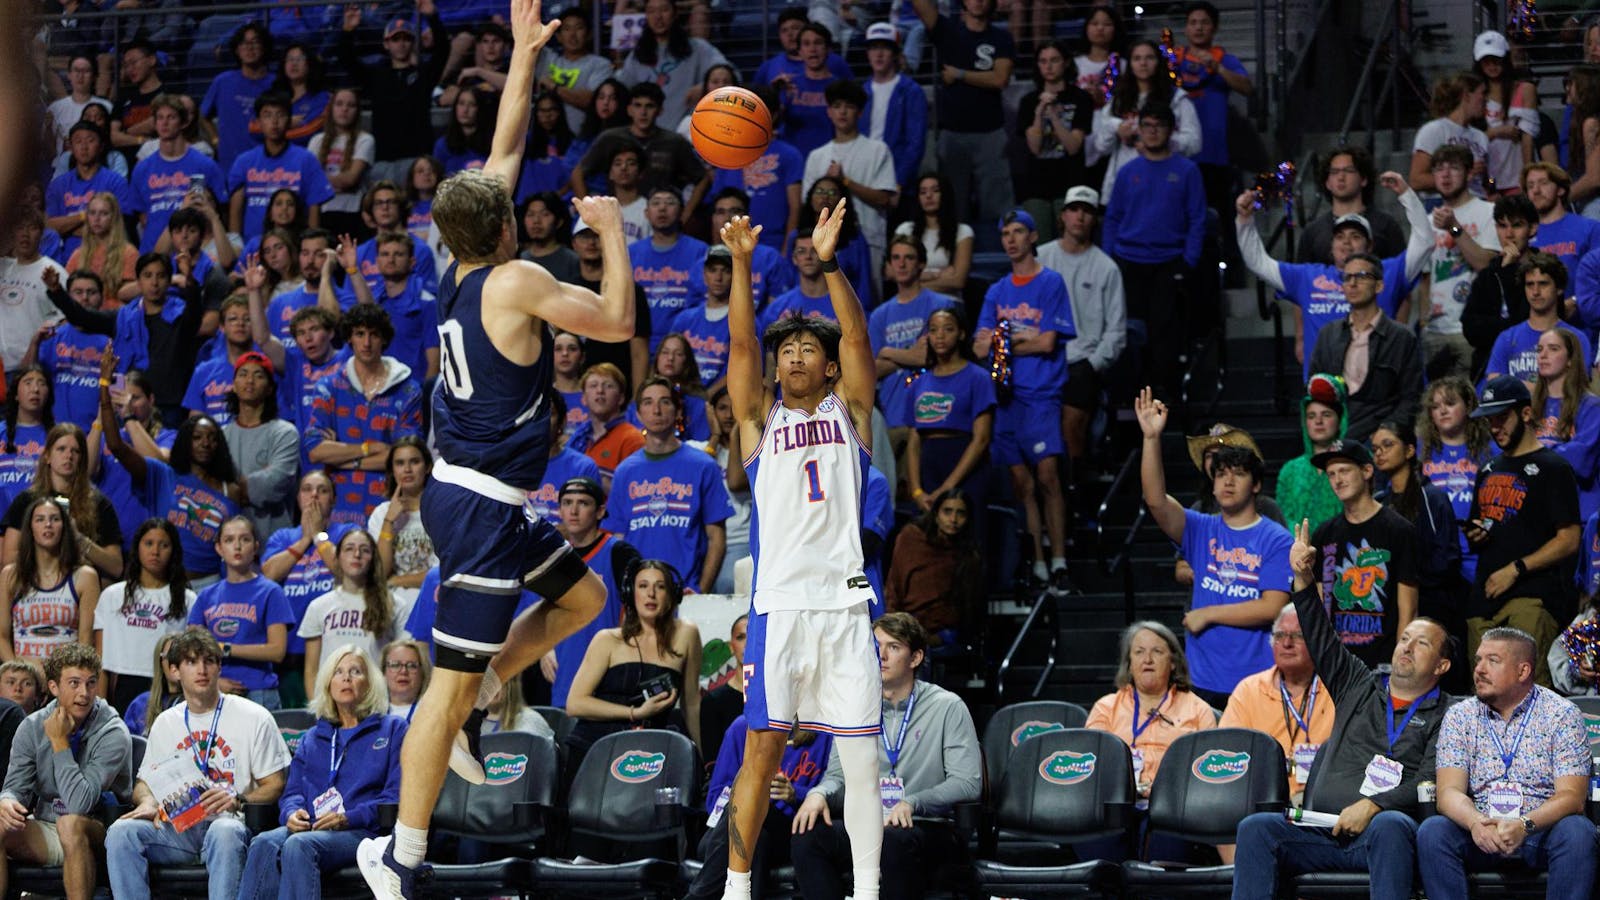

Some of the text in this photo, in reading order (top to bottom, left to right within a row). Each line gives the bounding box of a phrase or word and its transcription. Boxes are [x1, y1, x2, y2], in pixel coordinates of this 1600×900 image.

[974, 44, 996, 71] S
[773, 419, 847, 456] FLORIDA
[804, 459, 826, 503] 1
[629, 514, 689, 531] STAY HOT!
[284, 582, 312, 598] STAY
[1201, 576, 1226, 595] STAY
